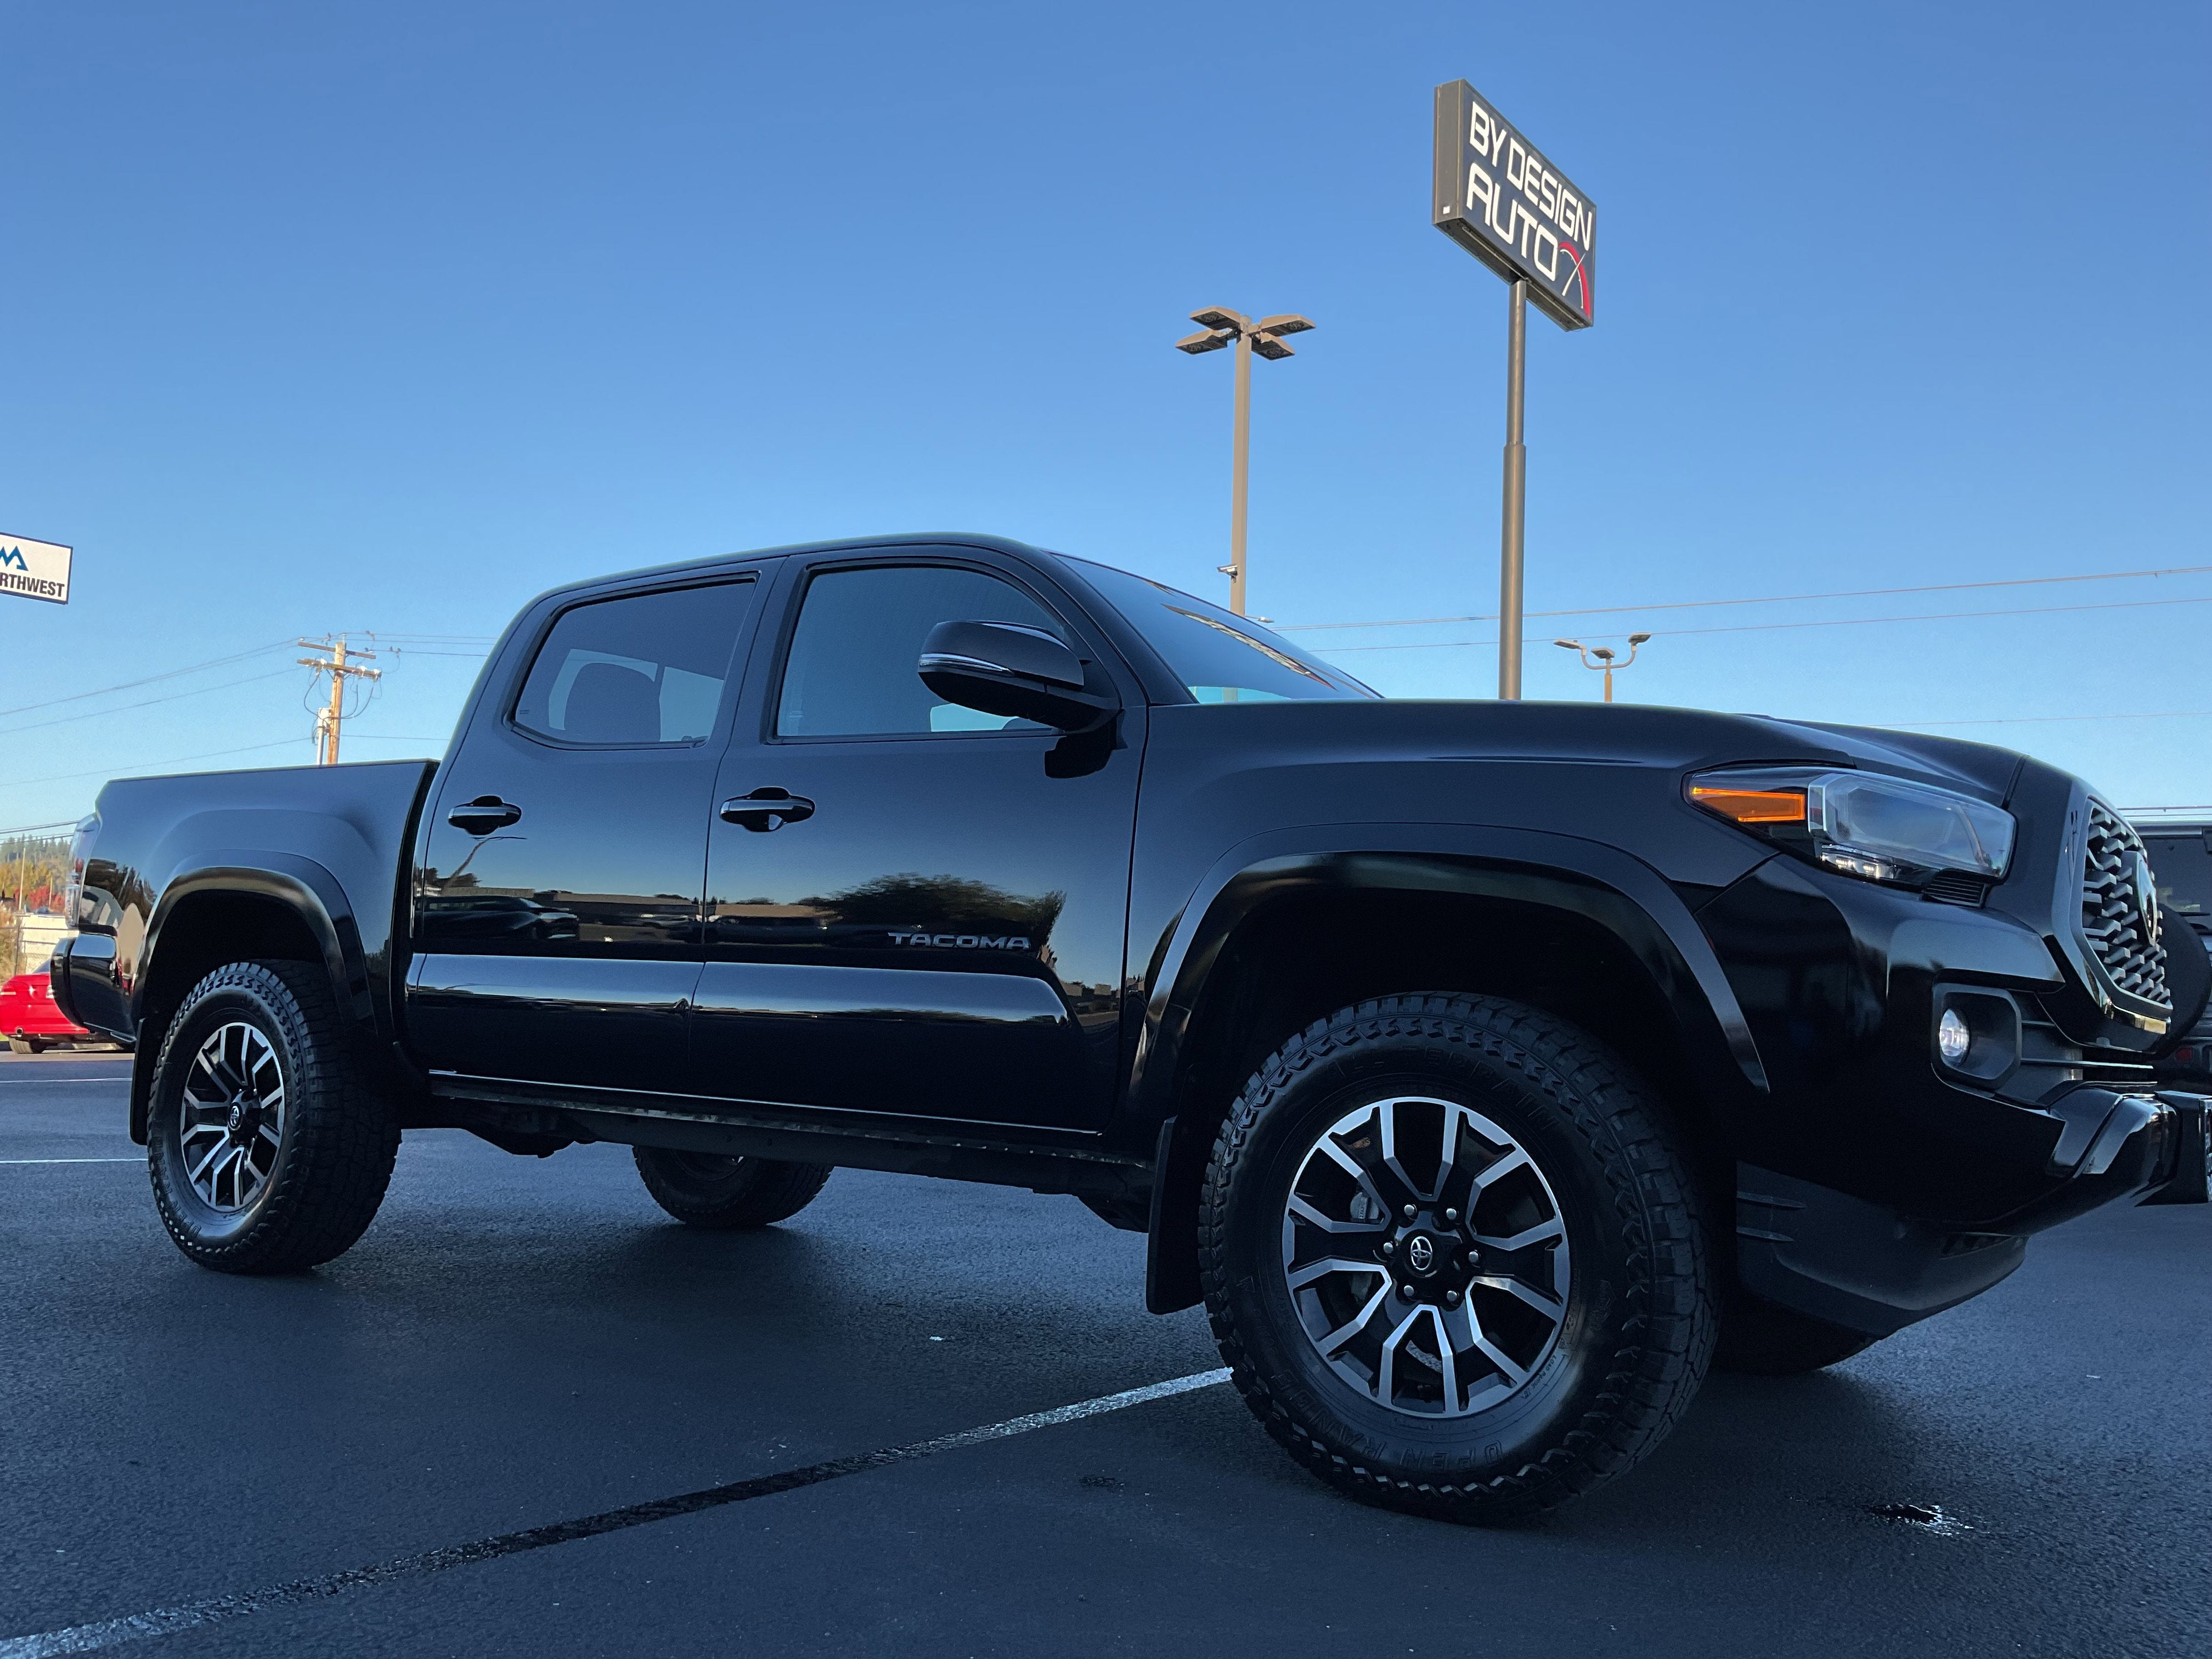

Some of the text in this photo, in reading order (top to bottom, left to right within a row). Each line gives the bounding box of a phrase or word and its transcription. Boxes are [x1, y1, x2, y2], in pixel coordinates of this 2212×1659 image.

[1466, 163, 1558, 281] AUTO
[1470, 101, 1593, 251] BY DESIGN
[888, 932, 1031, 950] TACOMA
